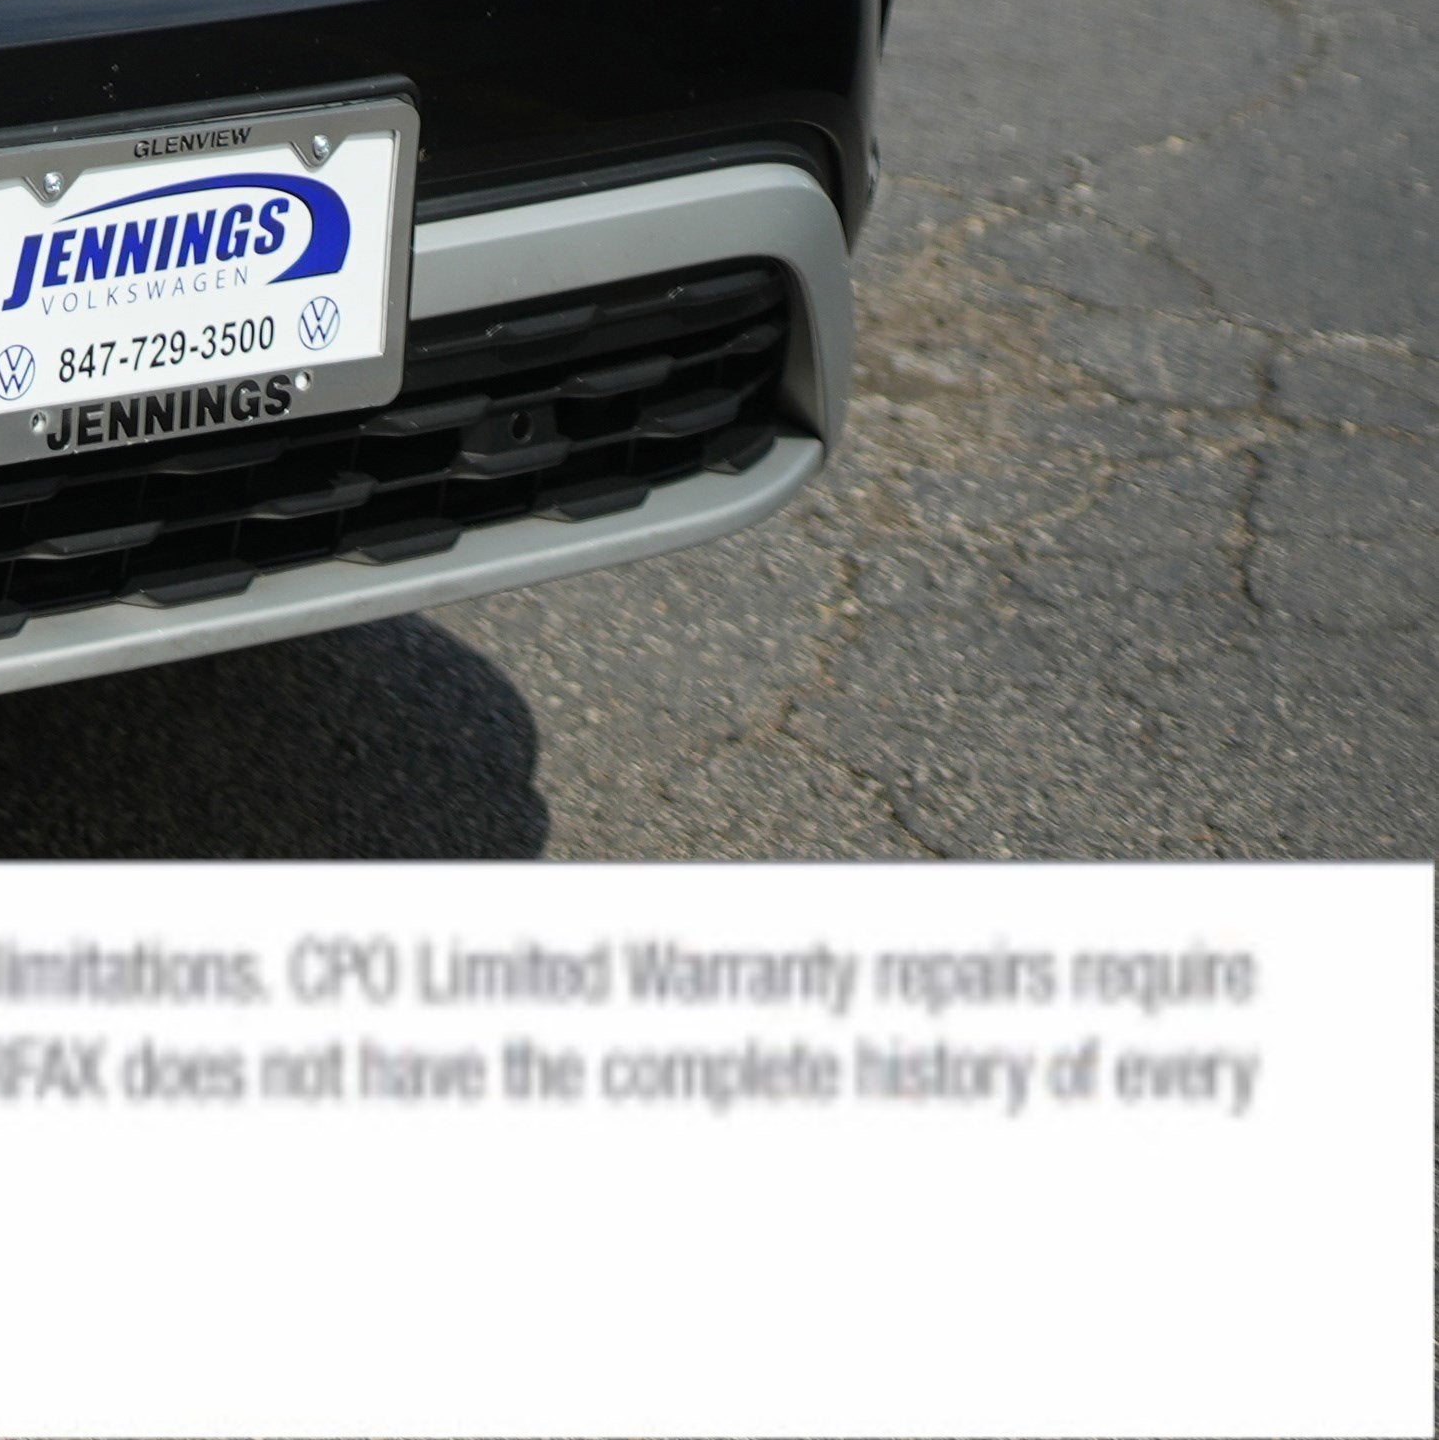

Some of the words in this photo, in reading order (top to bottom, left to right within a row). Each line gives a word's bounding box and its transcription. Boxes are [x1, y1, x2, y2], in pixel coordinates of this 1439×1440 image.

[133, 126, 252, 160] GLENVIEW
[0, 196, 290, 313] JENNINGS
[40, 265, 250, 317] VOLKSWAGEN
[57, 315, 276, 384] 847-729-3500
[46, 373, 294, 452] JENNINGS
